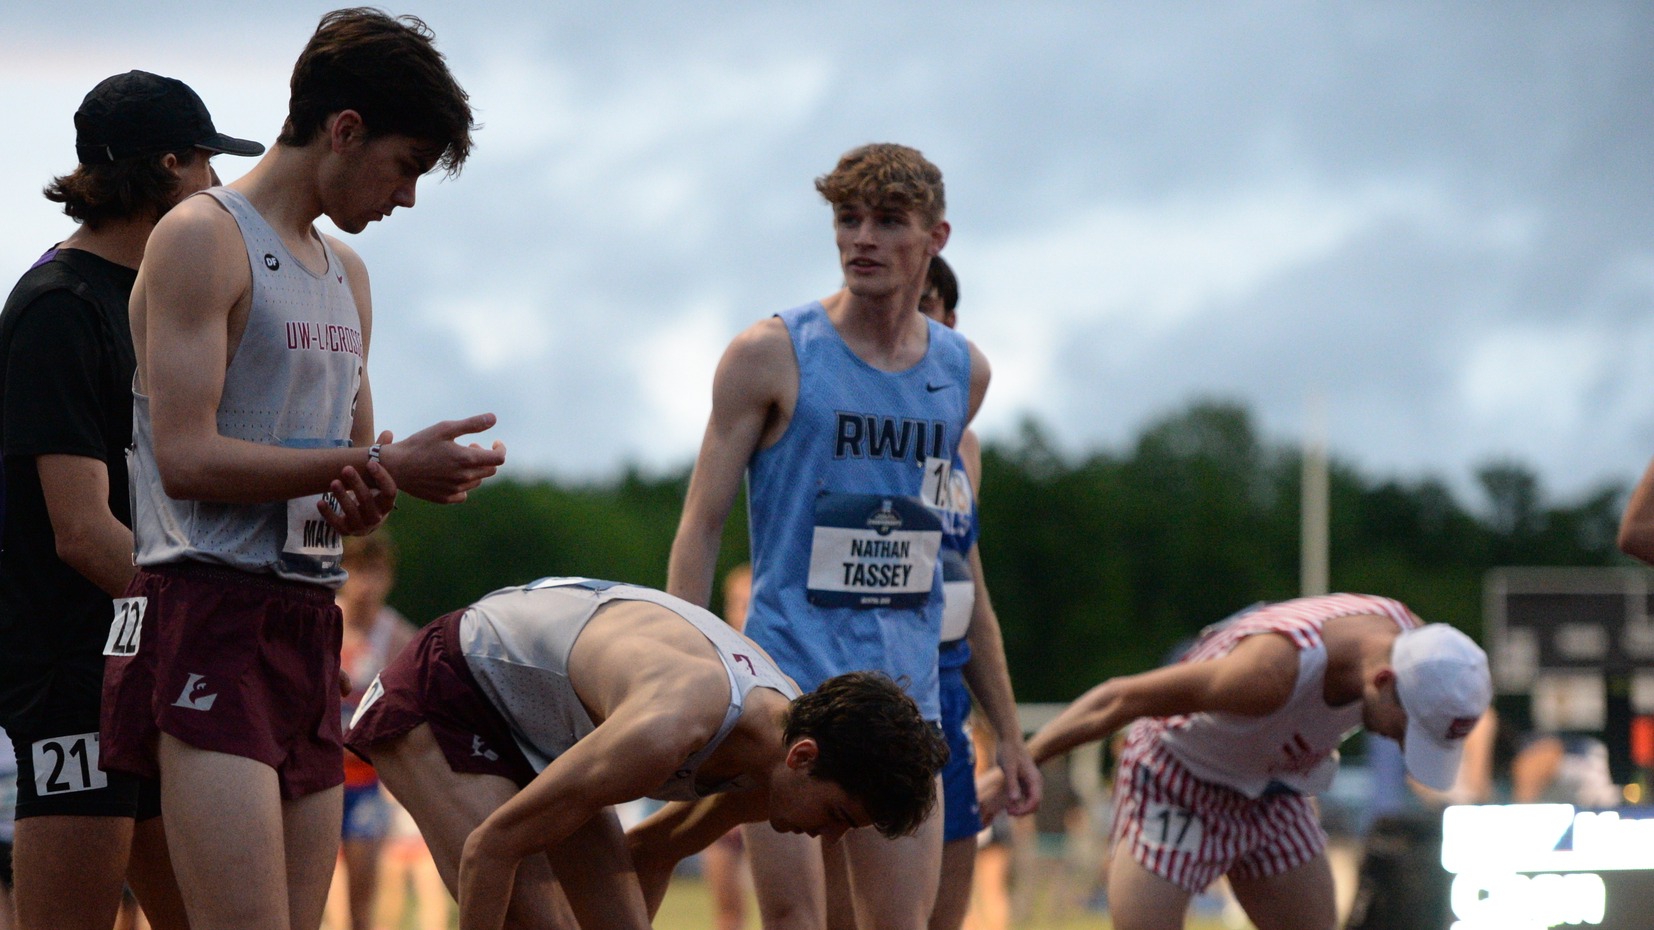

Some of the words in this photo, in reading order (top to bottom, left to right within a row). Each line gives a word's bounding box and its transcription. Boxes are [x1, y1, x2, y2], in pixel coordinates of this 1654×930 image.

[265, 257, 278, 267] DF
[834, 410, 946, 463] RWU
[851, 539, 911, 558] NATHAN
[843, 562, 912, 588] TASSEY
[111, 600, 141, 654] 22
[42, 738, 92, 793] 21
[1159, 808, 1194, 847] 17
